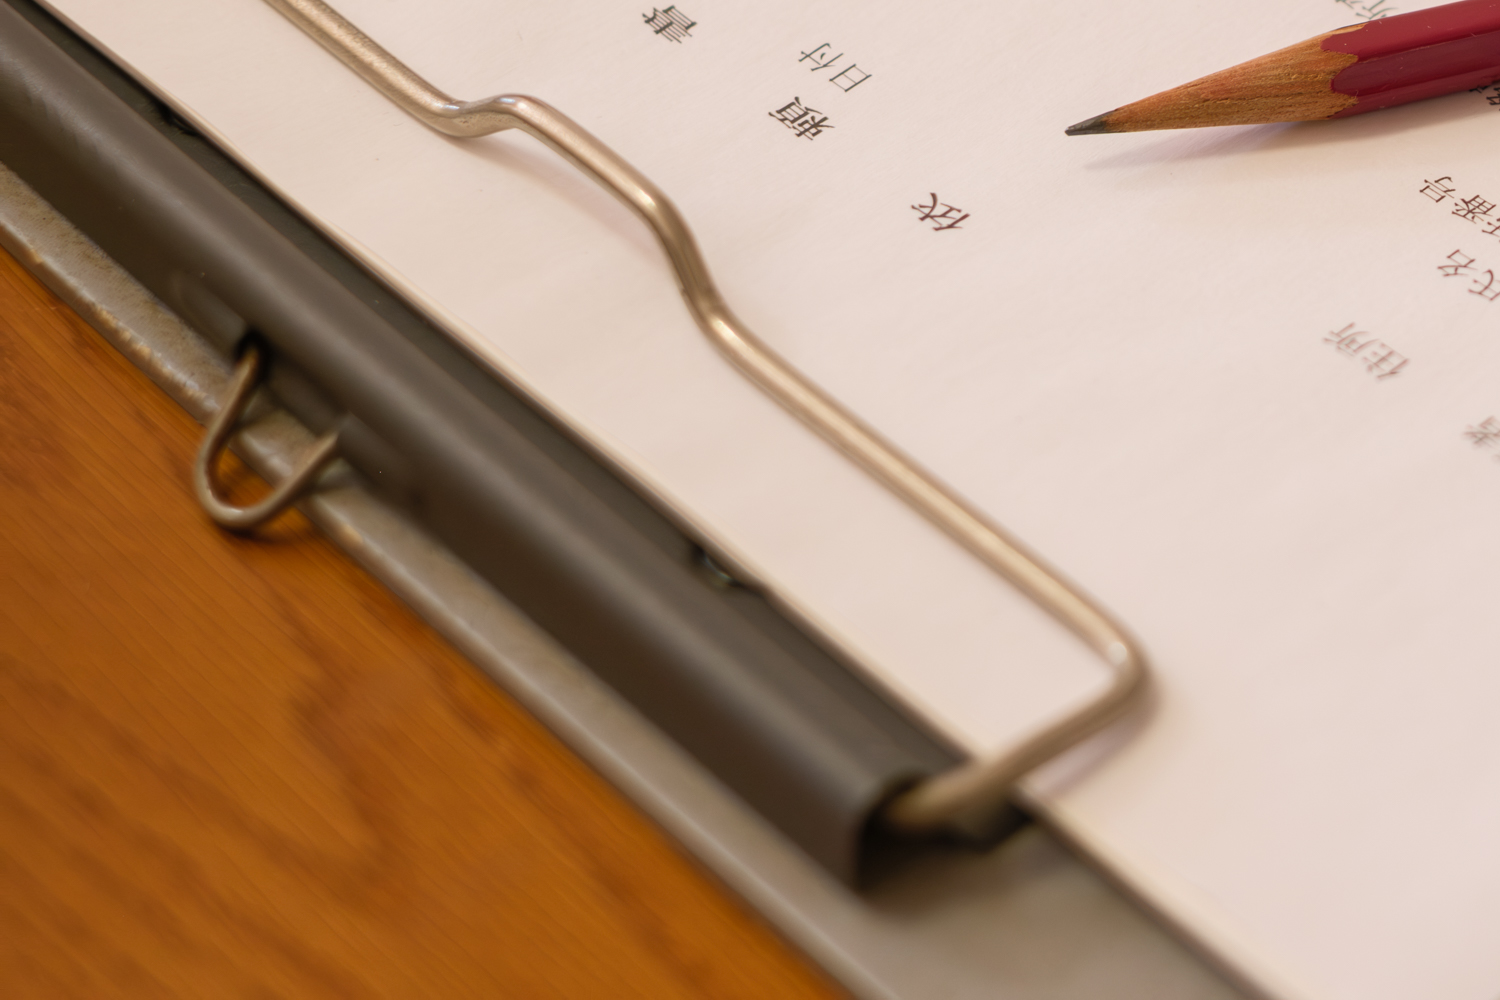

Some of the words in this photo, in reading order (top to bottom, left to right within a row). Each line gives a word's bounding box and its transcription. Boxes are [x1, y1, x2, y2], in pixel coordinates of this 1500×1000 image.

[642, 5, 697, 43] 書
[798, 43, 872, 92] 日付
[768, 96, 834, 140] 頼
[911, 193, 970, 231] 依
[1323, 322, 1409, 381] 住所
